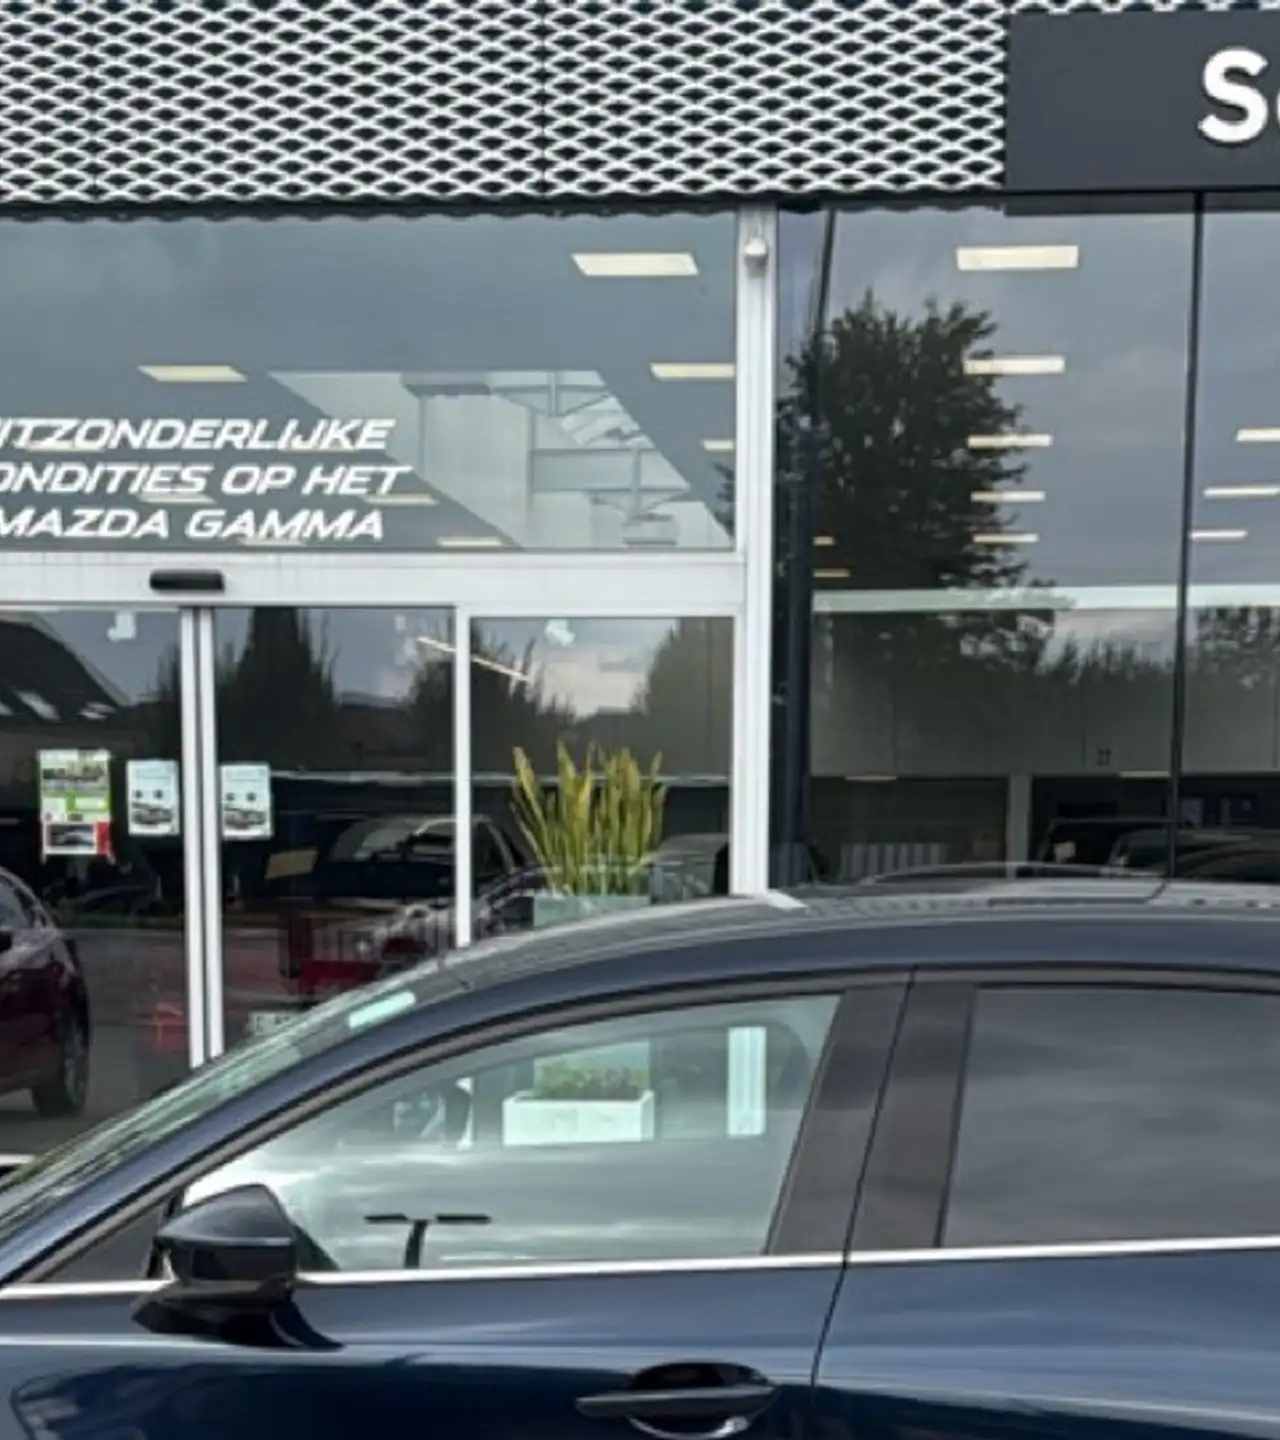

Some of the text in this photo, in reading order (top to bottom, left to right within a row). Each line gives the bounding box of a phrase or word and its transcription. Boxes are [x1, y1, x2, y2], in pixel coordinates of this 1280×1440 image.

[221, 465, 296, 495] OP
[299, 465, 414, 497] HET
[184, 509, 384, 541] GAMMA
